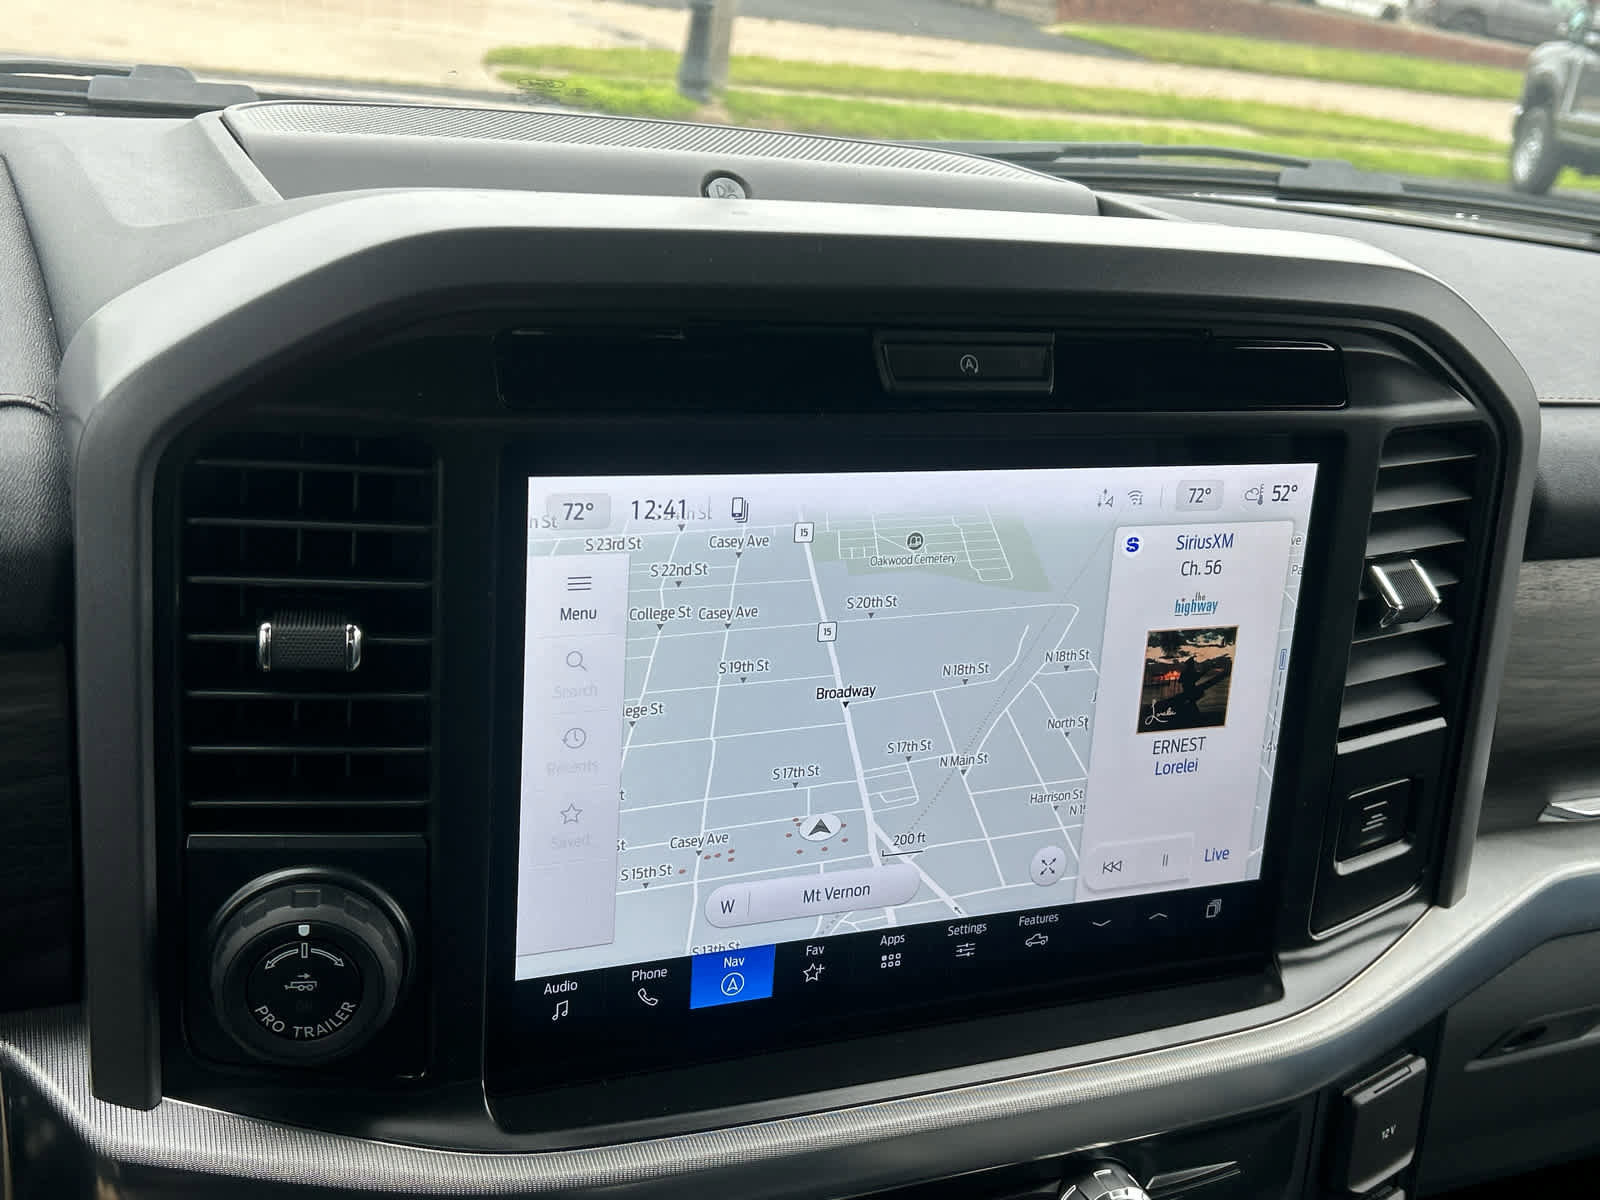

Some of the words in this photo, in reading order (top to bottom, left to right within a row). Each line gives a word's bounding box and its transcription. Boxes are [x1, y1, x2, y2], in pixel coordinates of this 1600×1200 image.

[1271, 484, 1299, 502] 52°
[563, 502, 594, 521] 72°
[631, 499, 686, 520] 12:41
[585, 539, 594, 551] S
[597, 538, 625, 551] 23rd
[627, 537, 642, 550] St
[709, 536, 745, 549] Casey
[746, 535, 769, 547] Ave
[1176, 533, 1235, 550] SiriusXM
[870, 555, 913, 566] Oakwood
[914, 553, 956, 566] Cemetery
[650, 565, 659, 577] S
[662, 563, 692, 576] 22nd
[693, 563, 708, 575] St
[1181, 560, 1202, 576] Ch.
[1204, 560, 1222, 575] 56
[847, 598, 855, 609] S
[857, 596, 884, 609] 20th
[885, 595, 897, 607] St
[1174, 599, 1219, 616] highway
[560, 607, 597, 621] Menu
[629, 608, 675, 622] College
[679, 606, 692, 618] St
[699, 607, 733, 621] Casey
[735, 606, 758, 618] Ave
[1045, 652, 1054, 663] N
[1055, 651, 1077, 662] 18th
[1078, 650, 1089, 661] St
[719, 663, 727, 674] S
[728, 661, 754, 673] 19th
[757, 660, 769, 672] St
[943, 665, 951, 676] N
[953, 664, 976, 676] 18th
[978, 663, 989, 674] St
[816, 685, 876, 700] Broadway
[650, 703, 664, 715] St
[1047, 717, 1075, 729] North
[1077, 716, 1088, 728] St
[888, 742, 895, 753] S
[896, 741, 918, 752] 17th
[920, 739, 932, 751] St
[1153, 736, 1207, 755] ERNEST
[940, 756, 947, 767] N
[950, 755, 975, 766] Main
[977, 753, 988, 764] St
[1155, 758, 1199, 776] Lorelei
[773, 769, 780, 780] S
[783, 767, 805, 778] 17th
[807, 765, 819, 777] St
[1030, 790, 1071, 804] Harrison
[1073, 789, 1083, 800] St
[670, 836, 704, 849] Casey
[707, 833, 729, 845] Ave
[893, 834, 915, 846] 200
[917, 833, 926, 843] ft
[1204, 848, 1230, 862] Live
[621, 869, 628, 881] S
[630, 867, 657, 879] 15th
[660, 865, 672, 877] St
[721, 899, 735, 914] W
[803, 888, 822, 903] Mt
[825, 884, 871, 900] Vernon
[1019, 913, 1059, 927] Features
[948, 922, 987, 936] Settings
[880, 934, 905, 946] Apps
[806, 945, 825, 956] Fav
[723, 956, 745, 969] Nav
[631, 968, 668, 982] Phone
[544, 980, 578, 995] Audio
[254, 1005, 286, 1033] PRO
[293, 1001, 356, 1038] TRAILER
